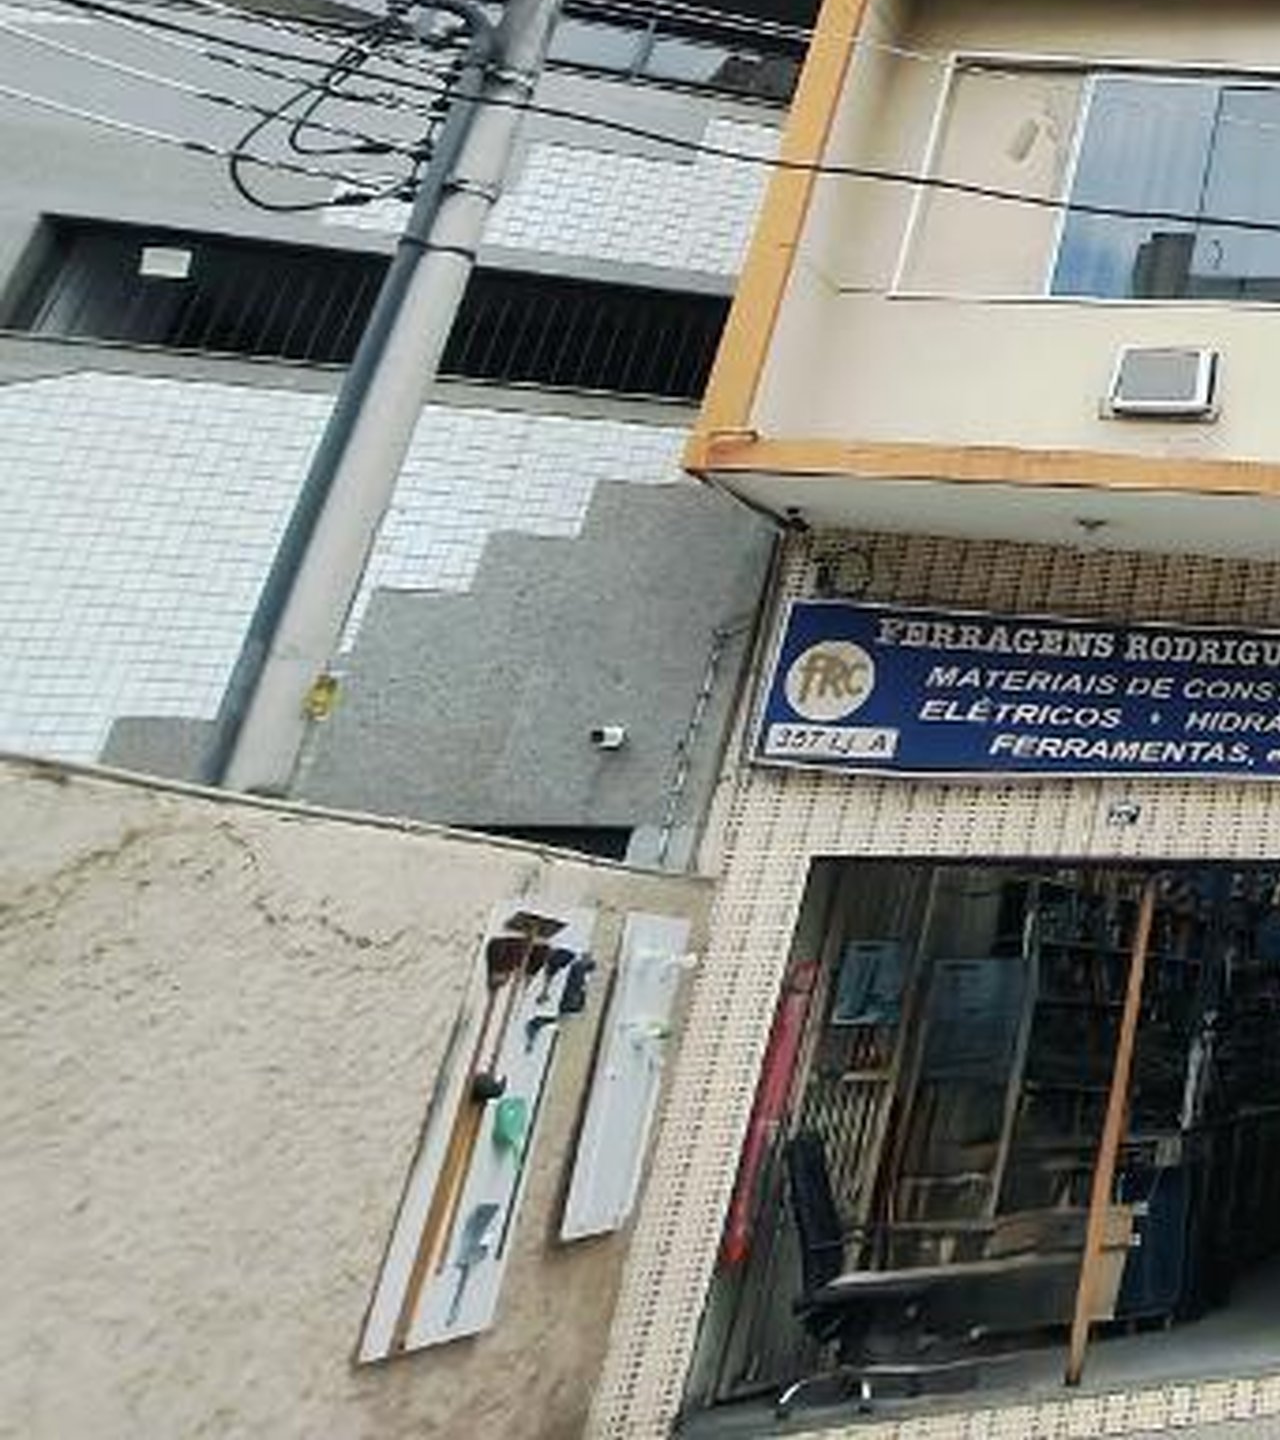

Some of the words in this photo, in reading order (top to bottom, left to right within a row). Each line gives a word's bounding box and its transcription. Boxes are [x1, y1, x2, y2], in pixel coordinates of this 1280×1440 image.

[874, 617, 1114, 658] FERRAGENS
[925, 665, 1118, 695] MATERIAIS
[1125, 677, 1174, 699] DE
[919, 694, 1123, 729] ELÉTRICOS
